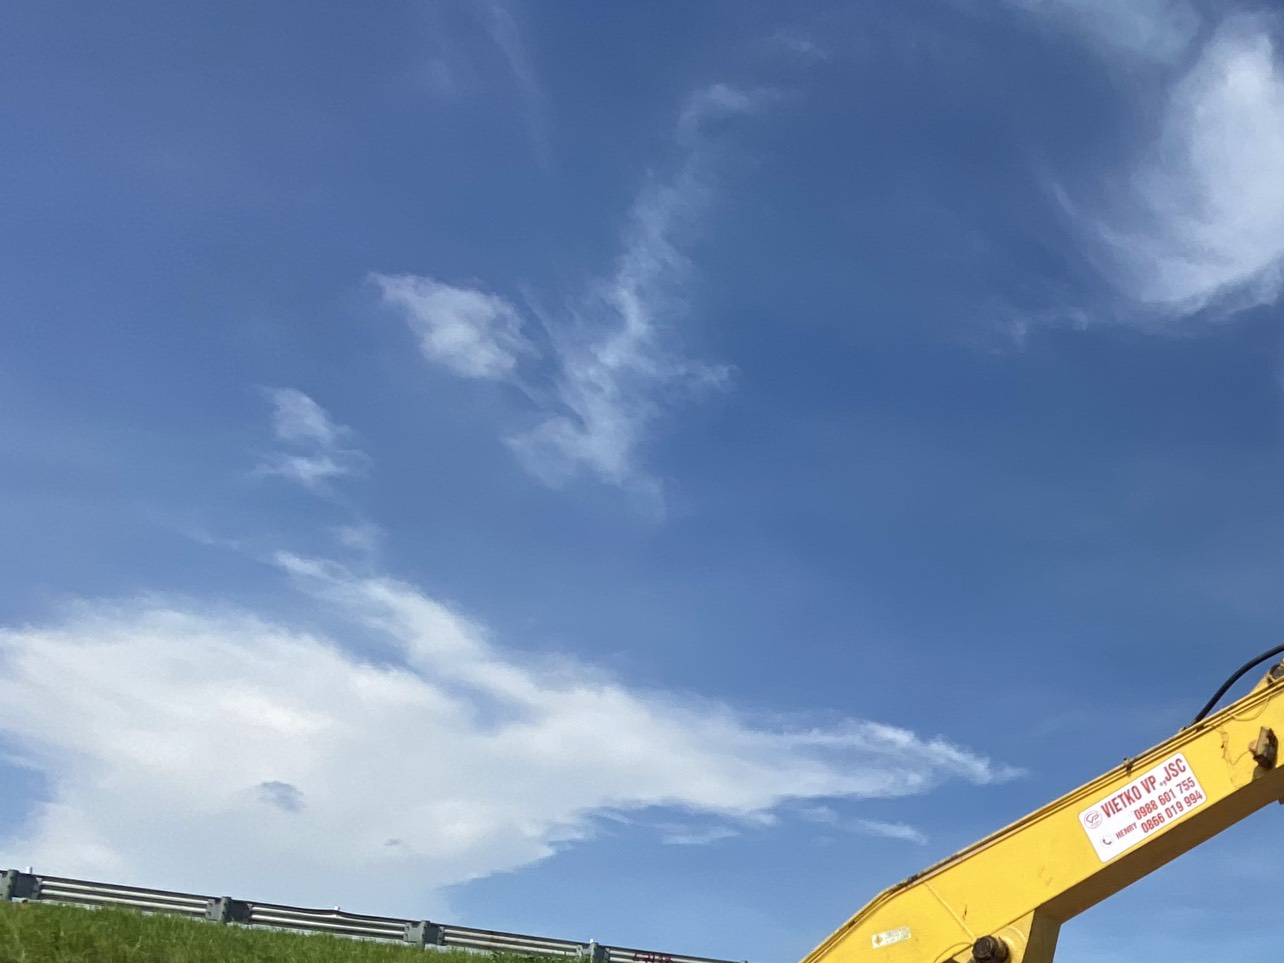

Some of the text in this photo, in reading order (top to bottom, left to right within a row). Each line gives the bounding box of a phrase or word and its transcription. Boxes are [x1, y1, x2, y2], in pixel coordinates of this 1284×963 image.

[1101, 785, 1142, 818] VIETKO
[1141, 775, 1156, 794] VP
[1134, 777, 1196, 820] 0988 601 755
[1141, 790, 1203, 833] 0866 019 994
[1115, 822, 1138, 839] HENRY
